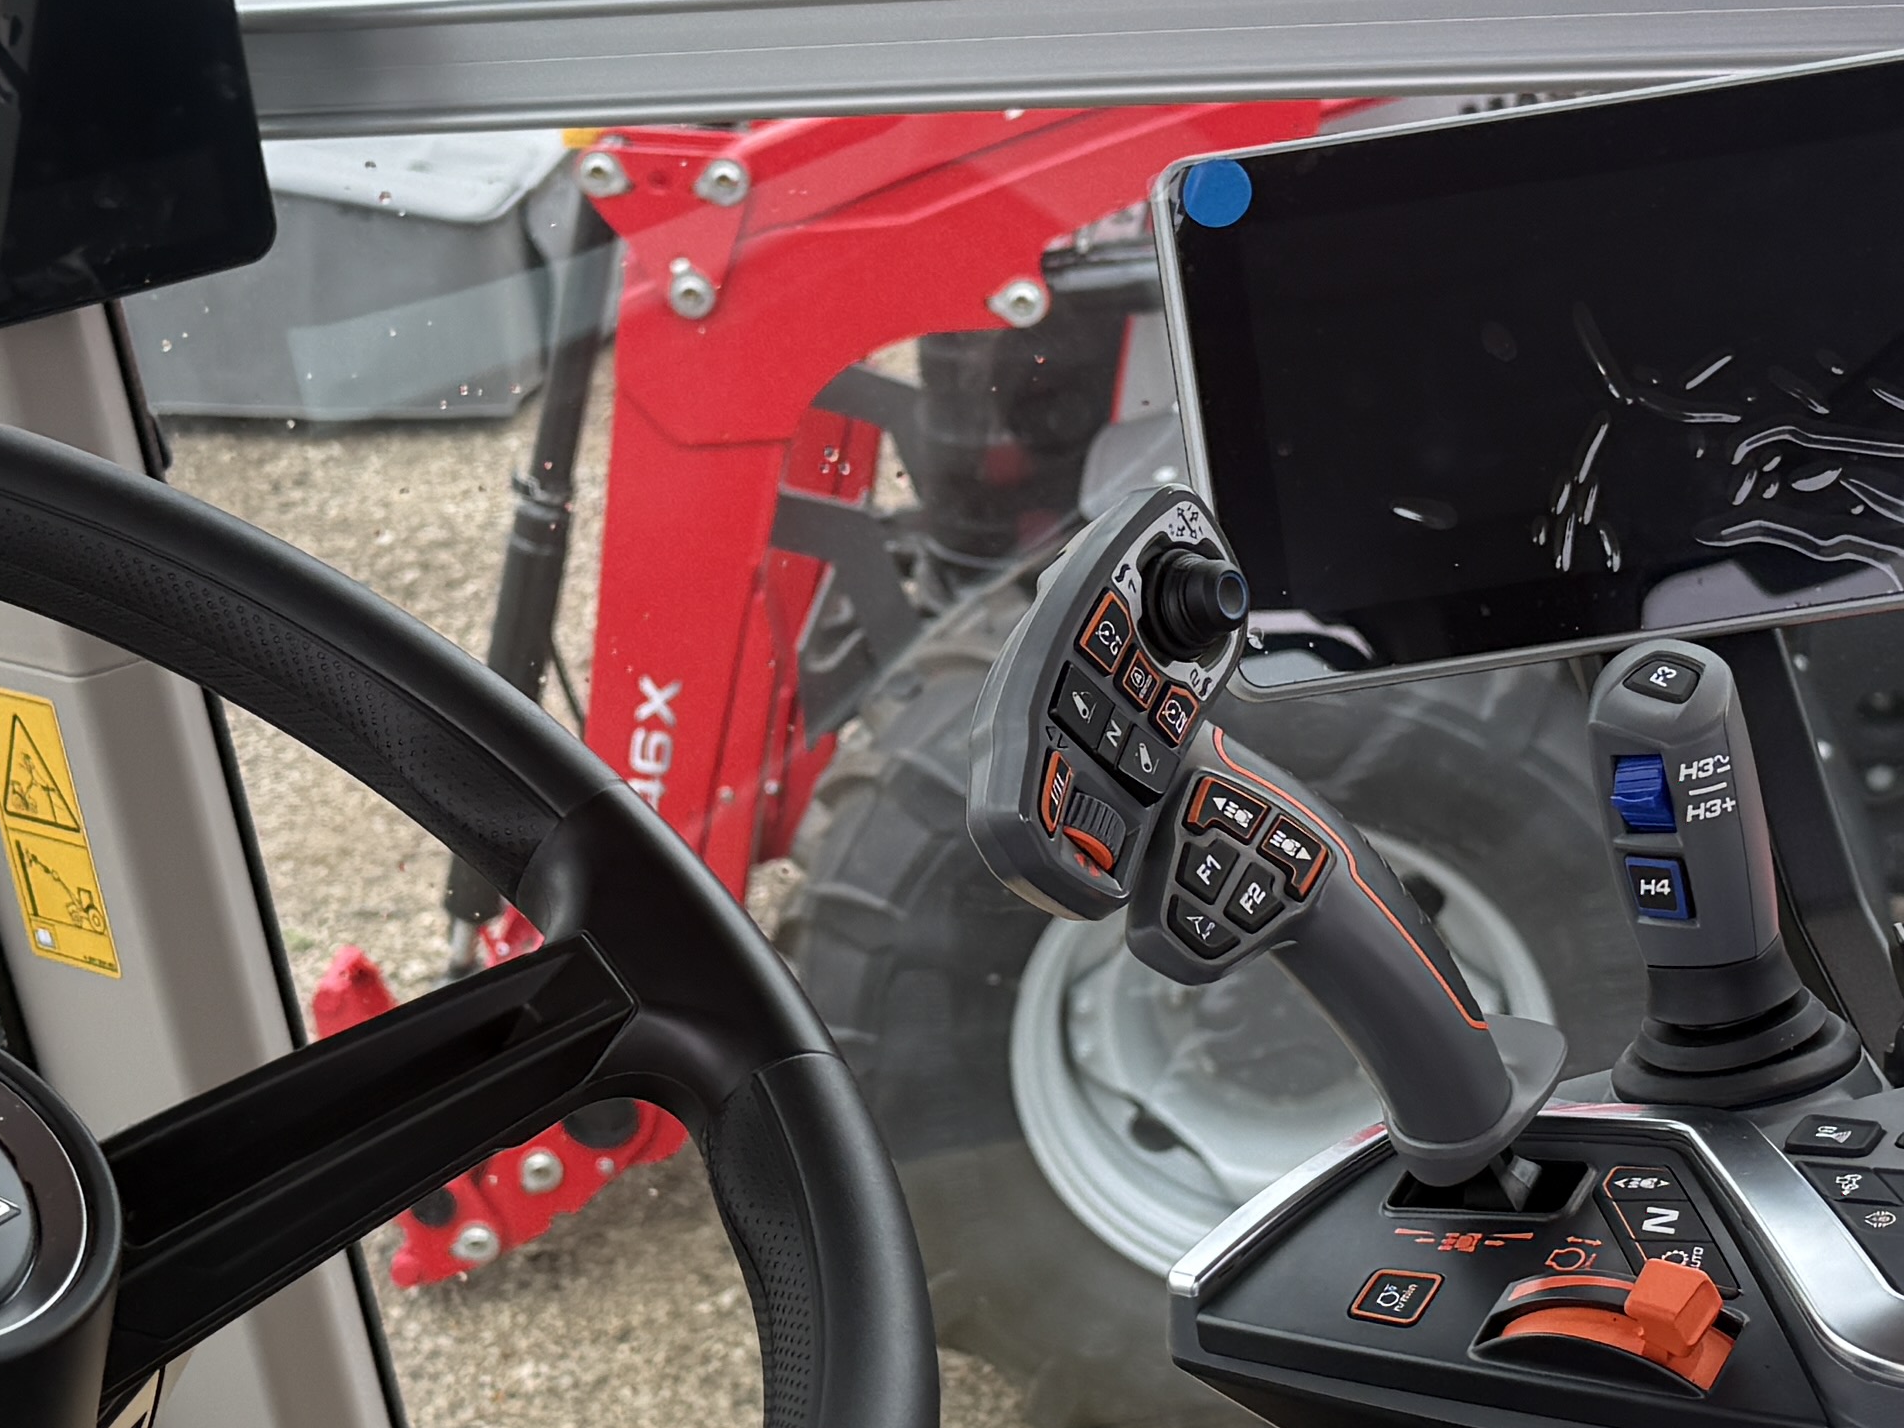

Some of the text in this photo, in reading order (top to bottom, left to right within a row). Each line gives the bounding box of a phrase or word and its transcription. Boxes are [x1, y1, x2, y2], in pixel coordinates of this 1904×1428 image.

[1649, 666, 1677, 687] F3
[1686, 796, 1736, 823] H3+
[1196, 854, 1222, 886] F1
[1239, 882, 1266, 914] F2
[1639, 878, 1671, 896] H4
[1642, 1206, 1680, 1235] N
[1690, 1246, 1704, 1269] UTO
